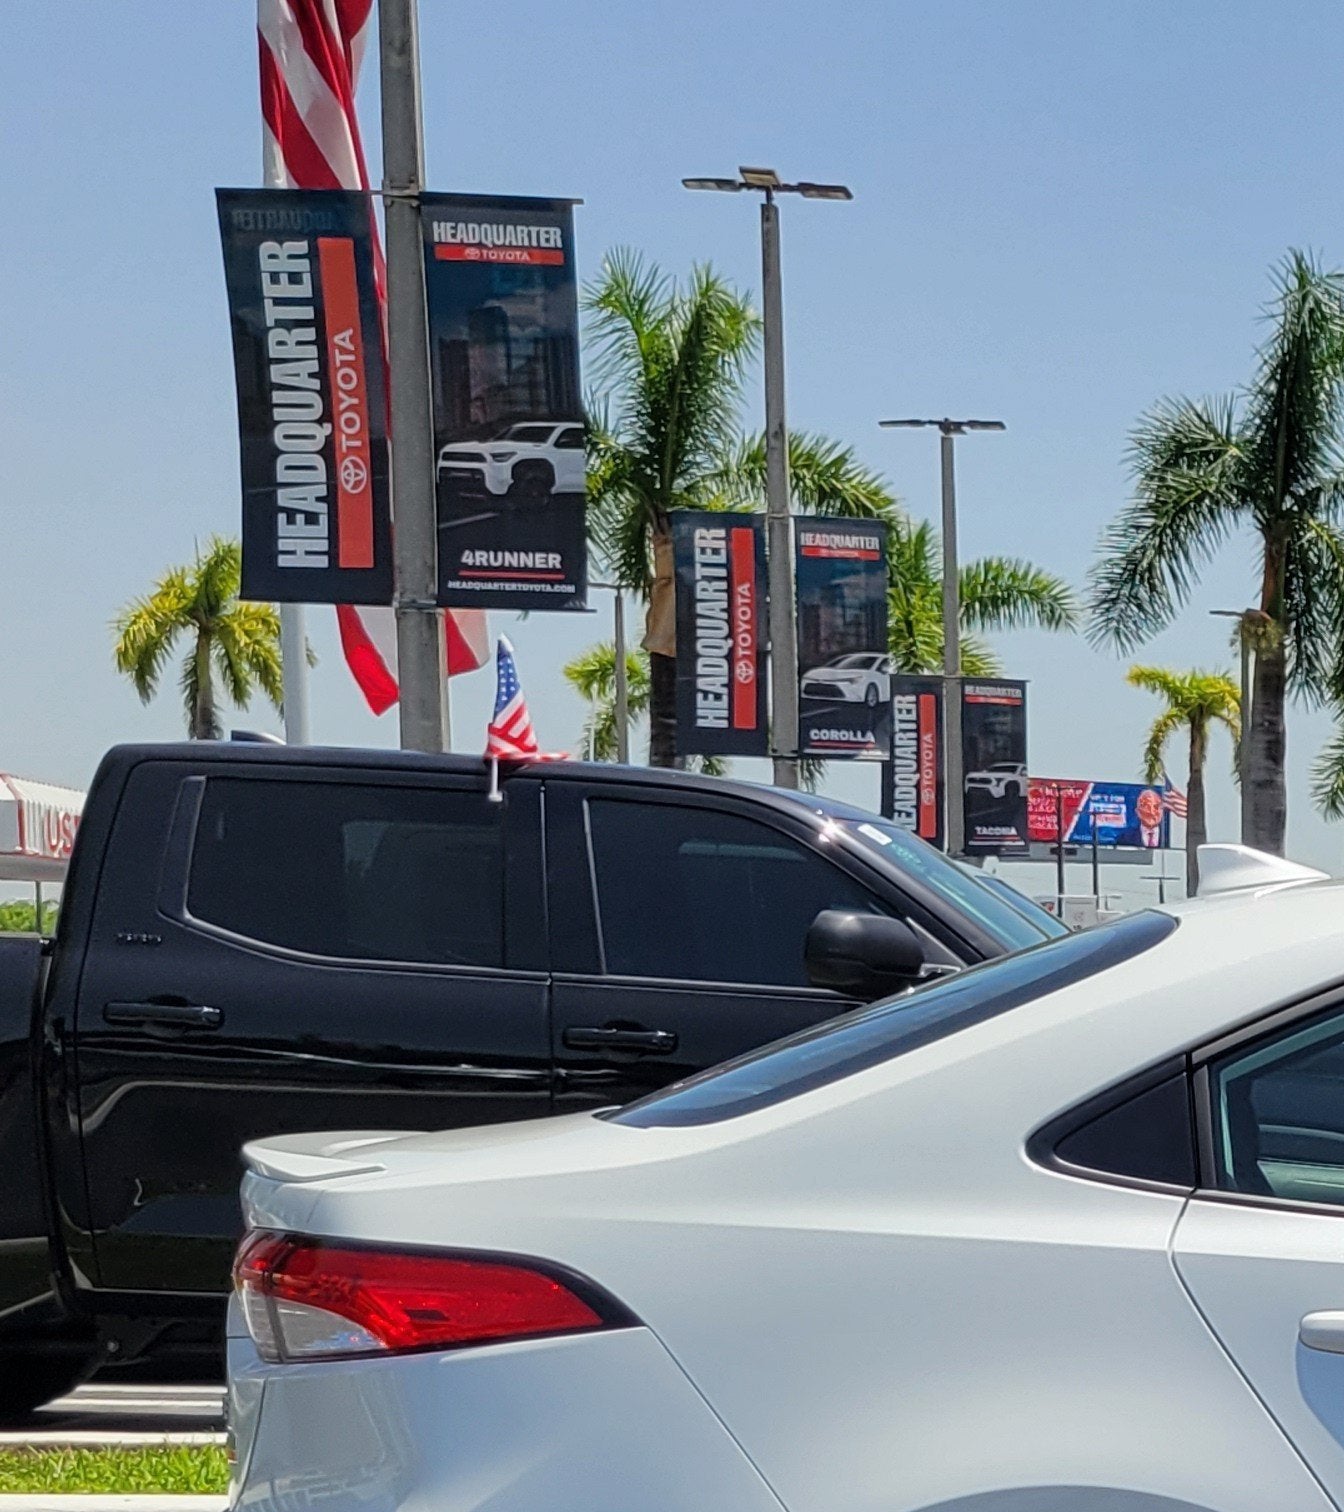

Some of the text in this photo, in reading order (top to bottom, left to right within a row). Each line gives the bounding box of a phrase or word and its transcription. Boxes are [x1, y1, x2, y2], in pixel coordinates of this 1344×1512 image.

[432, 221, 563, 248] HEADQUARTER
[482, 250, 530, 261] TOYOTA
[259, 240, 333, 569] HEADQUARTER
[332, 328, 360, 452] TOYOTA
[460, 549, 562, 569] 4RUNNER
[800, 532, 880, 550] HEADQUARTER
[695, 527, 734, 729] HEADQUARTER
[737, 582, 751, 657] TOYOTA
[809, 728, 876, 743] COROLLA
[922, 733, 934, 780] TOYOTA
